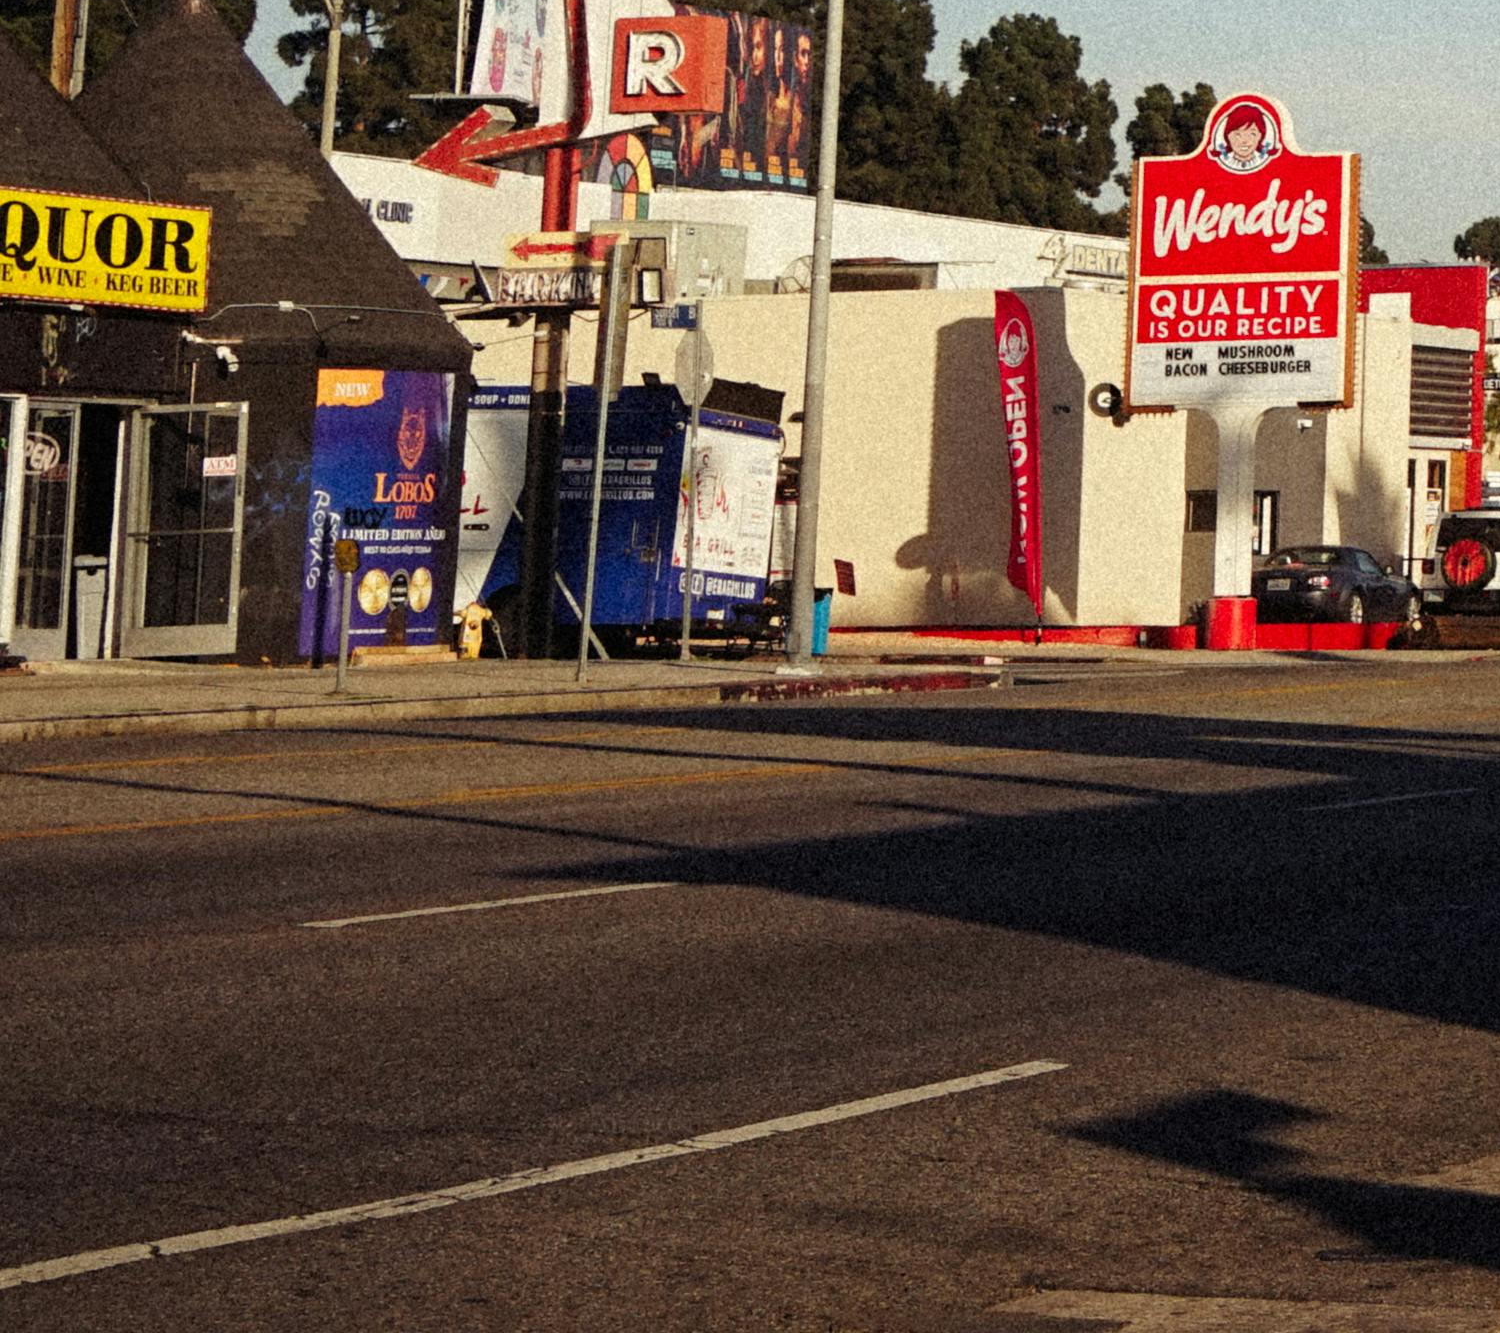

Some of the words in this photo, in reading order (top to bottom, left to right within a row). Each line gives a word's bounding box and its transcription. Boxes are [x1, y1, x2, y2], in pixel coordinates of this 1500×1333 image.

[1154, 178, 1327, 258] Wendy's
[0, 200, 198, 274] QUOR
[38, 265, 87, 288] WINE
[106, 273, 143, 293] KEG
[150, 276, 198, 297] BEER
[1150, 284, 1323, 320] QUALITY
[1150, 321, 1168, 339] IS
[1178, 319, 1228, 338] OUR
[1237, 317, 1322, 336] RECIPE
[1165, 347, 1193, 361] NEW
[1218, 345, 1295, 359] MUSHROOM
[1165, 363, 1207, 377] BACON
[1218, 361, 1311, 376] CHEESEBURGER
[334, 383, 371, 397] NEW
[207, 459, 235, 469] ATM
[373, 472, 436, 503] LOBOS
[394, 505, 418, 520] 1707
[342, 529, 390, 541] LIMITED
